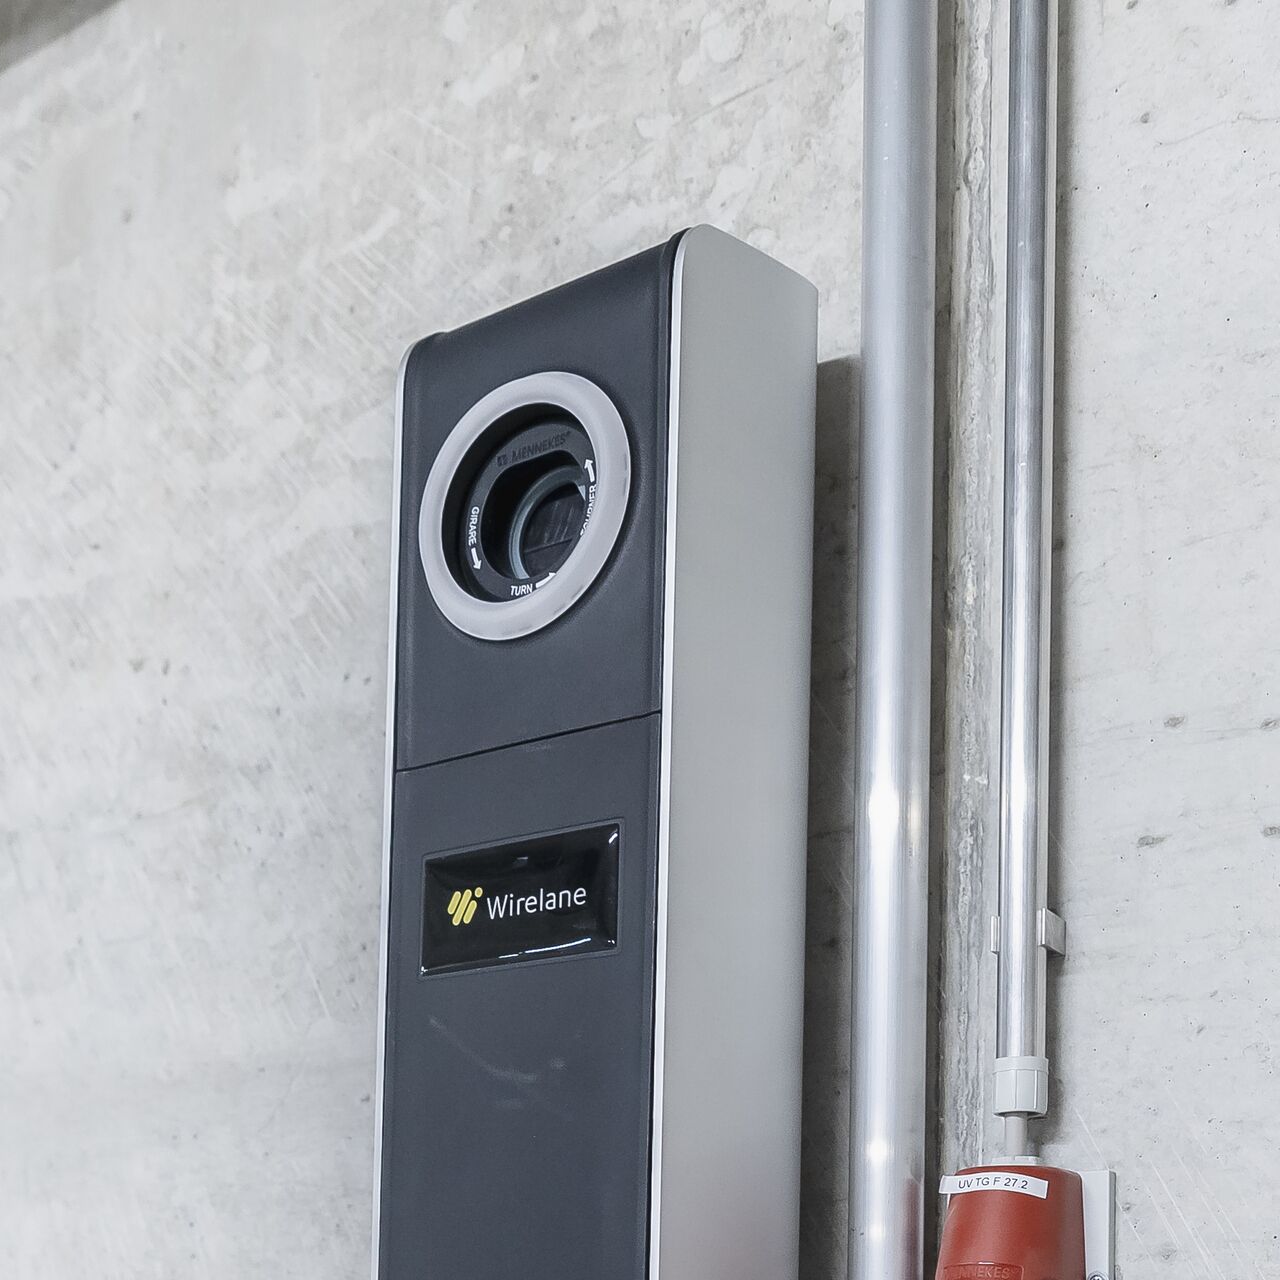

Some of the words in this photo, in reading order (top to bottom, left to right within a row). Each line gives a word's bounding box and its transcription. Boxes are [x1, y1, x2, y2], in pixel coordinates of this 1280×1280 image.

[468, 506, 480, 547] GIRARE
[510, 583, 533, 596] TURN
[487, 887, 587, 920] Wirelane
[958, 1179, 973, 1189] UV
[975, 1177, 990, 1186] TG
[993, 1177, 1001, 1186] F
[1004, 1178, 1029, 1190] 27.2
